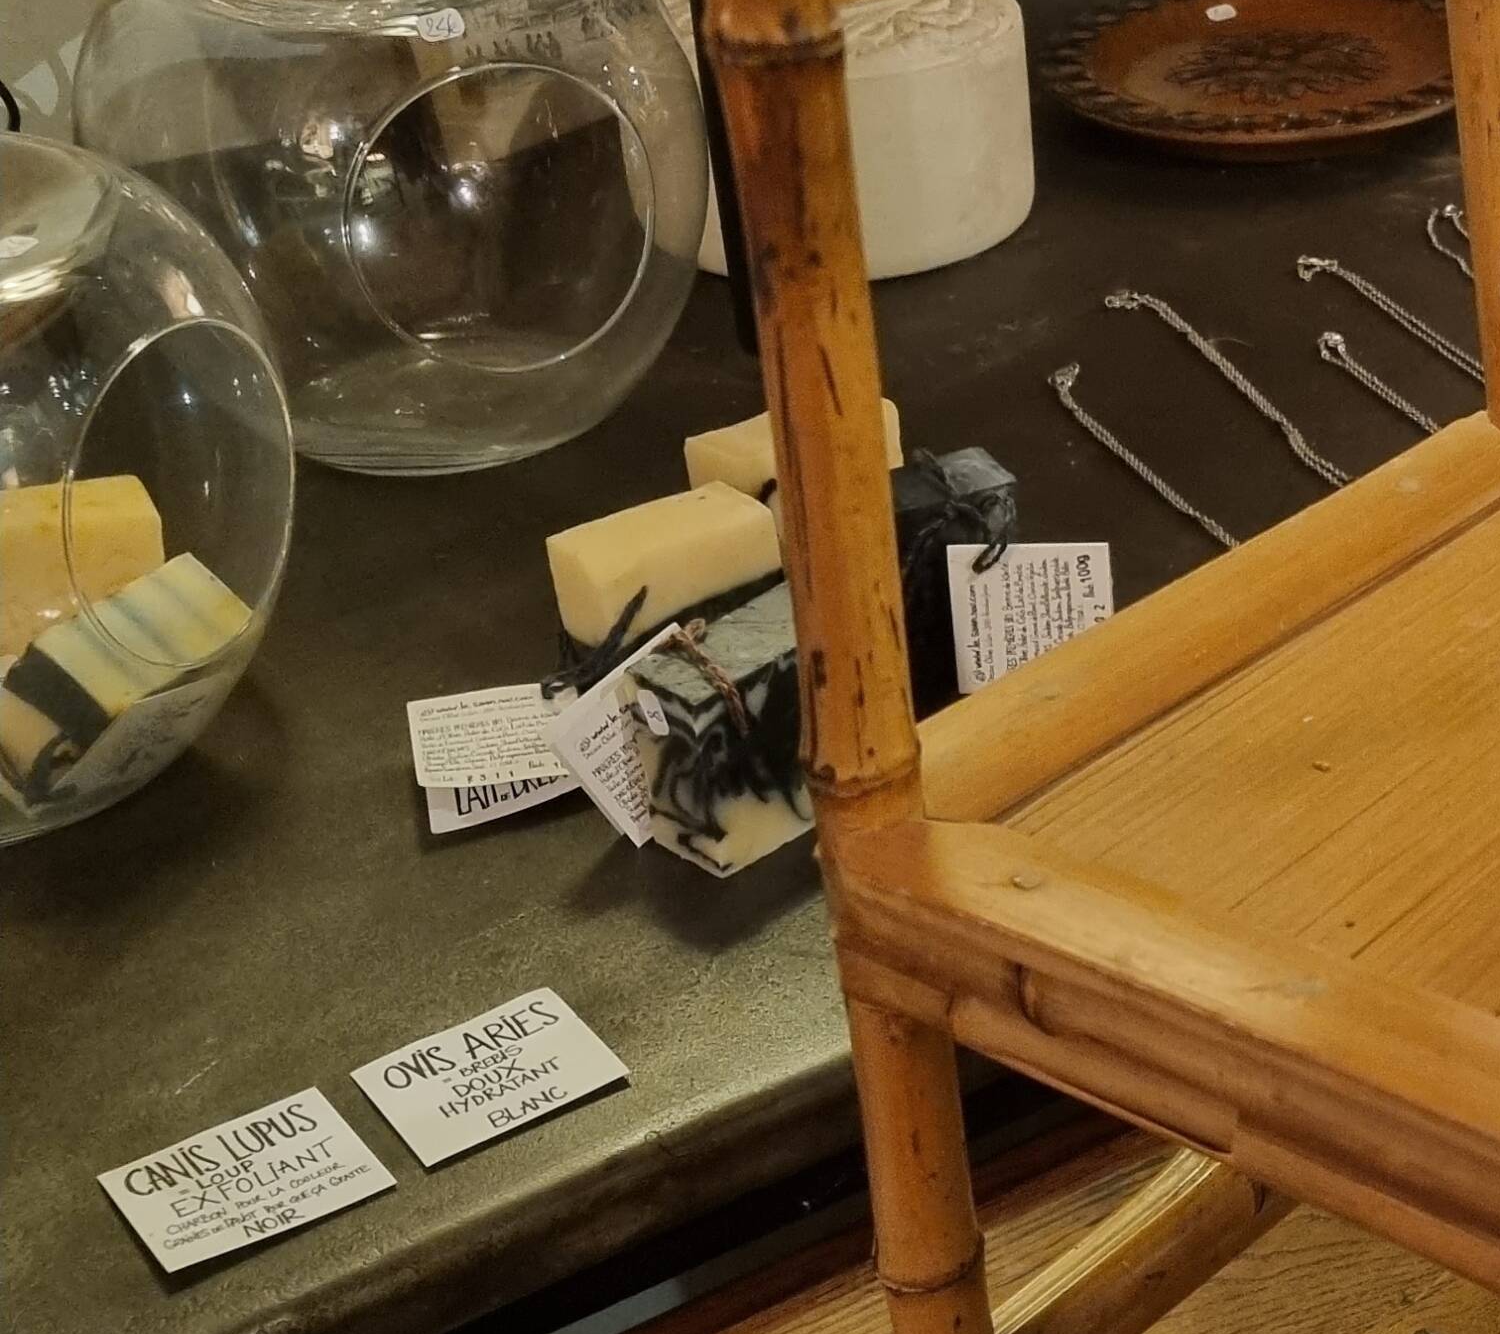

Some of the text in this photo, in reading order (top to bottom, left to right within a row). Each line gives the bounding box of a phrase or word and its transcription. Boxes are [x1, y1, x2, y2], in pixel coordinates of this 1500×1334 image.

[1076, 554, 1092, 582] 100g
[452, 1058, 526, 1098] DOUX
[459, 1044, 523, 1078] BREBIS
[438, 1056, 560, 1118] HYDRATANT
[487, 1086, 568, 1128] BLANC
[216, 1103, 318, 1162] LUPUS
[195, 1160, 254, 1189] LOUP
[166, 1162, 346, 1235] CHARBON POUR LA COULEUR
[243, 1208, 305, 1238] NOIR
